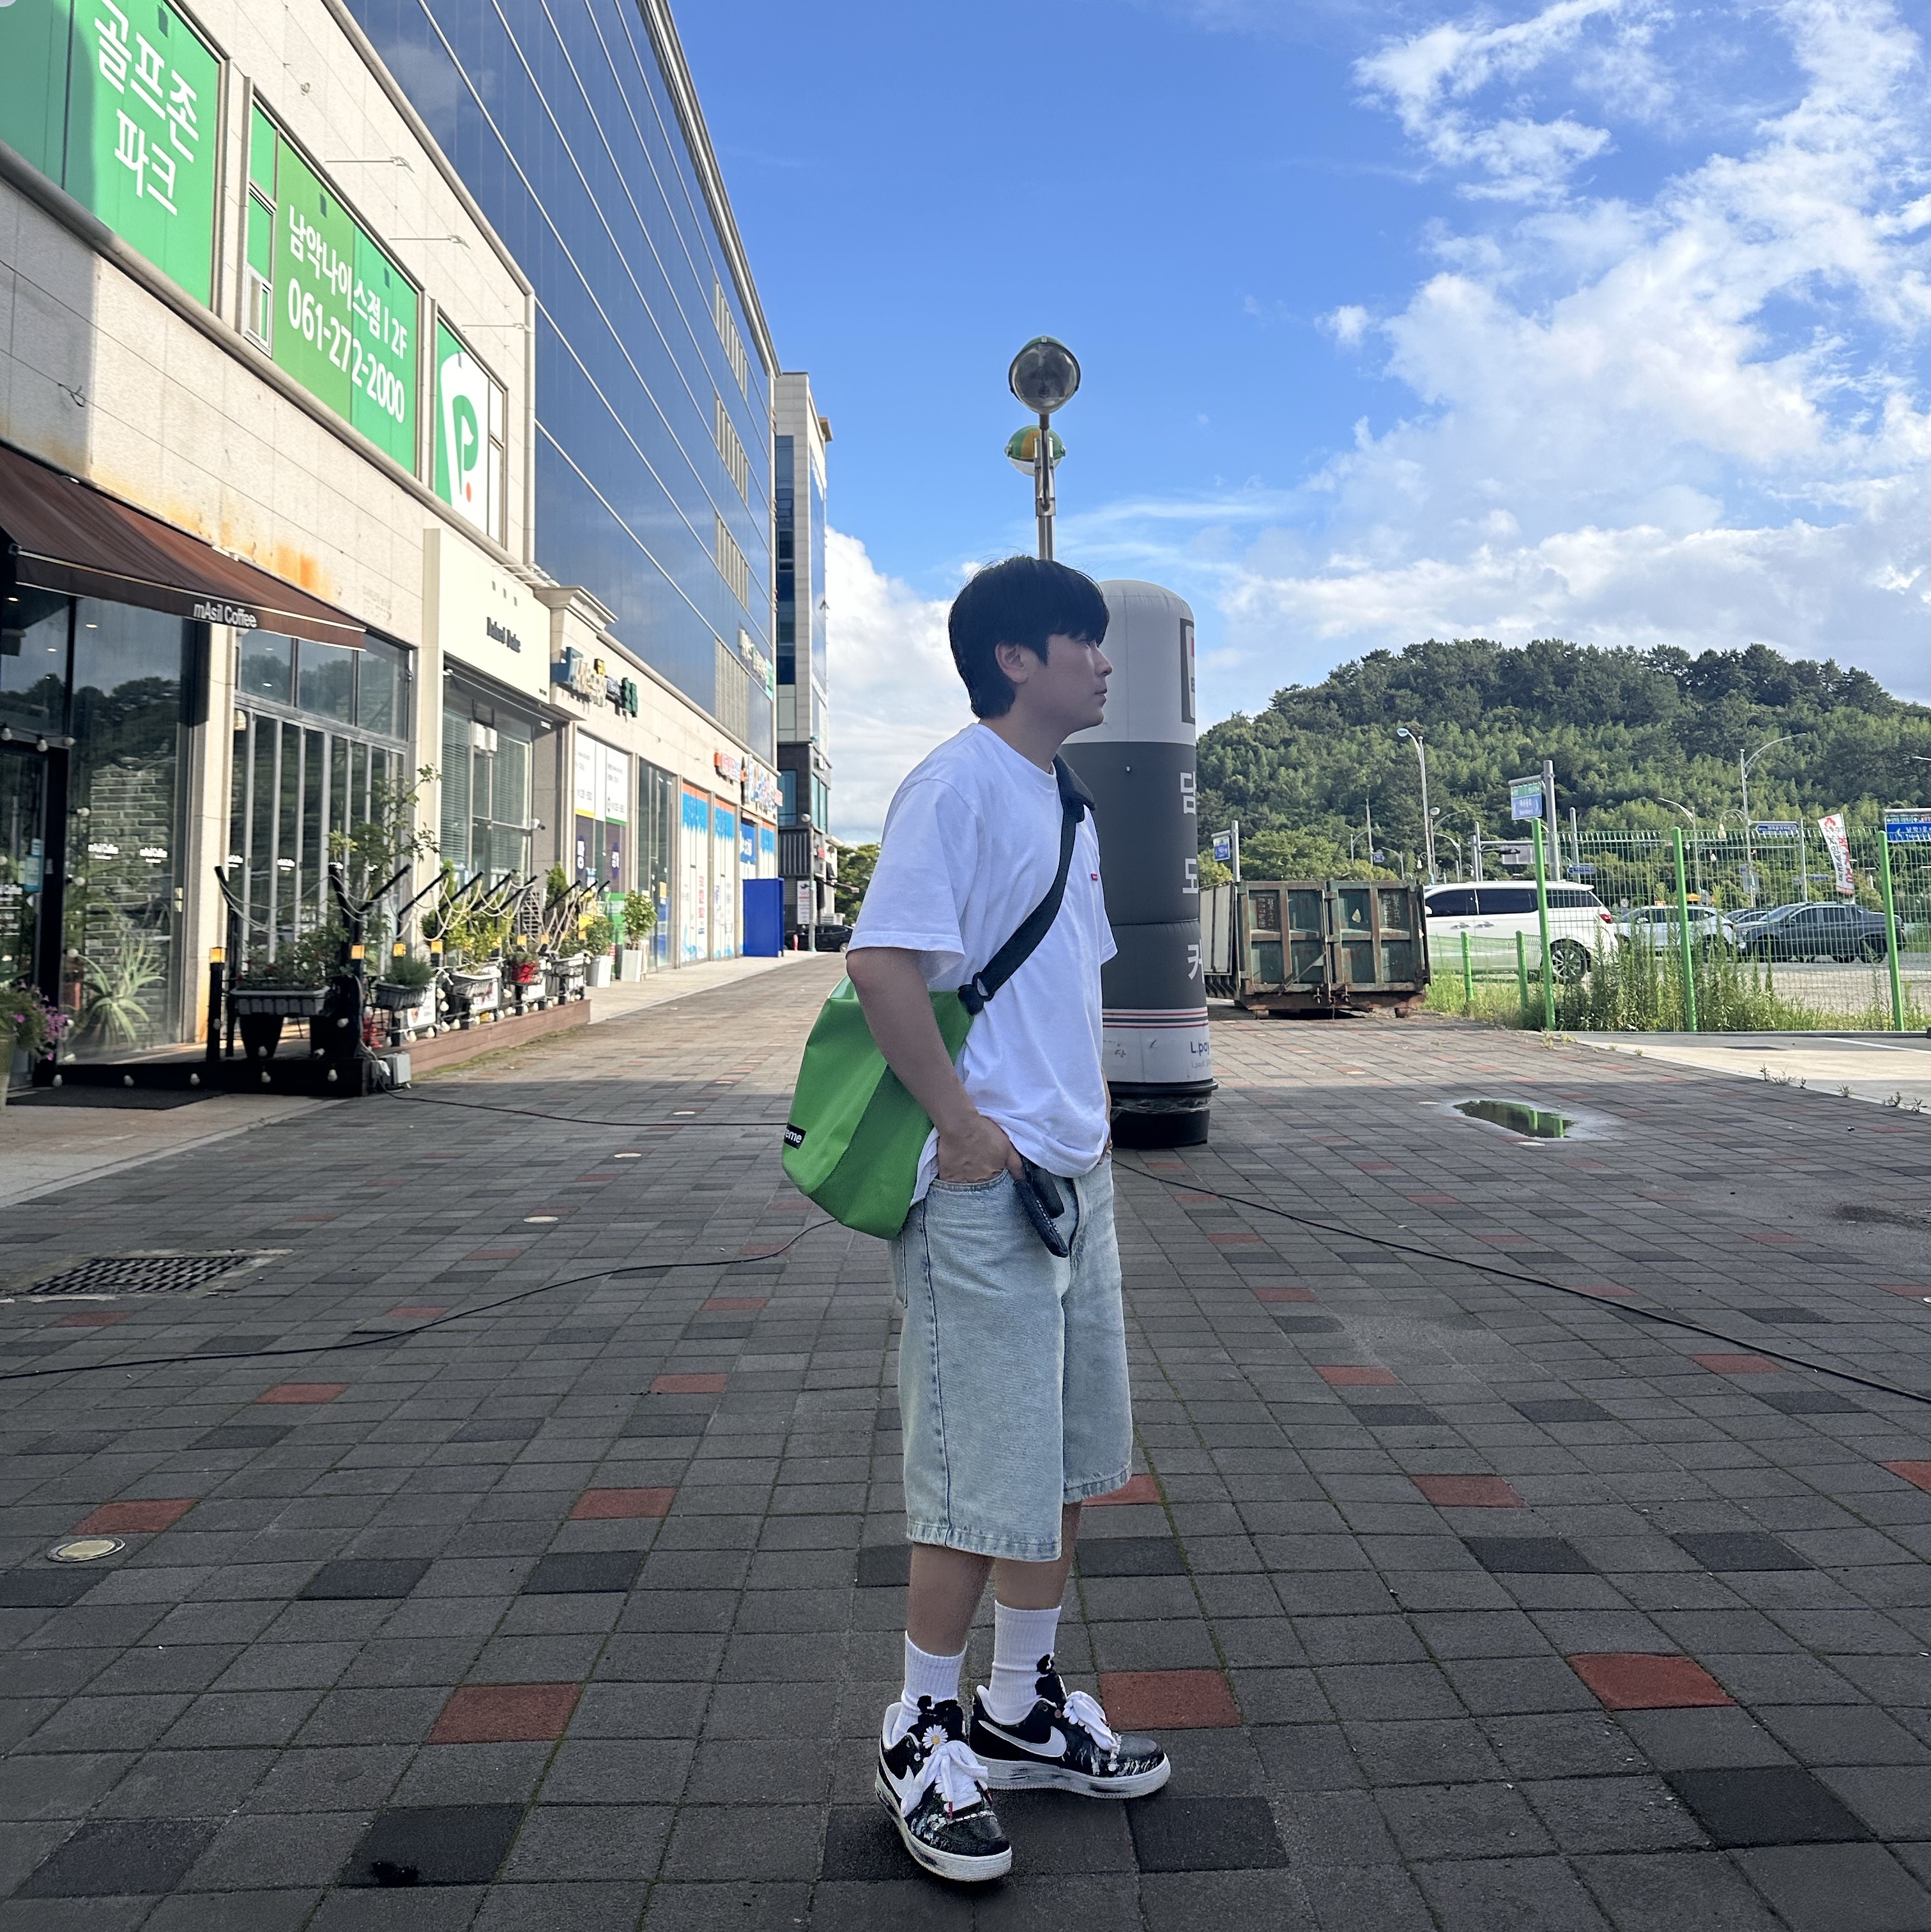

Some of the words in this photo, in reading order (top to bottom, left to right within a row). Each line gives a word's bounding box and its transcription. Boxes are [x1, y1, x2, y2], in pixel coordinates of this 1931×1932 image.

[95, 0, 199, 163] 골프존
[114, 108, 178, 216] 파크
[289, 204, 380, 339] 남악나이스점
[391, 317, 407, 359] 2F
[287, 278, 405, 423] 061-272-2000
[193, 601, 223, 622] mAsil
[224, 605, 258, 628] Coffee
[785, 1129, 802, 1143] eme
